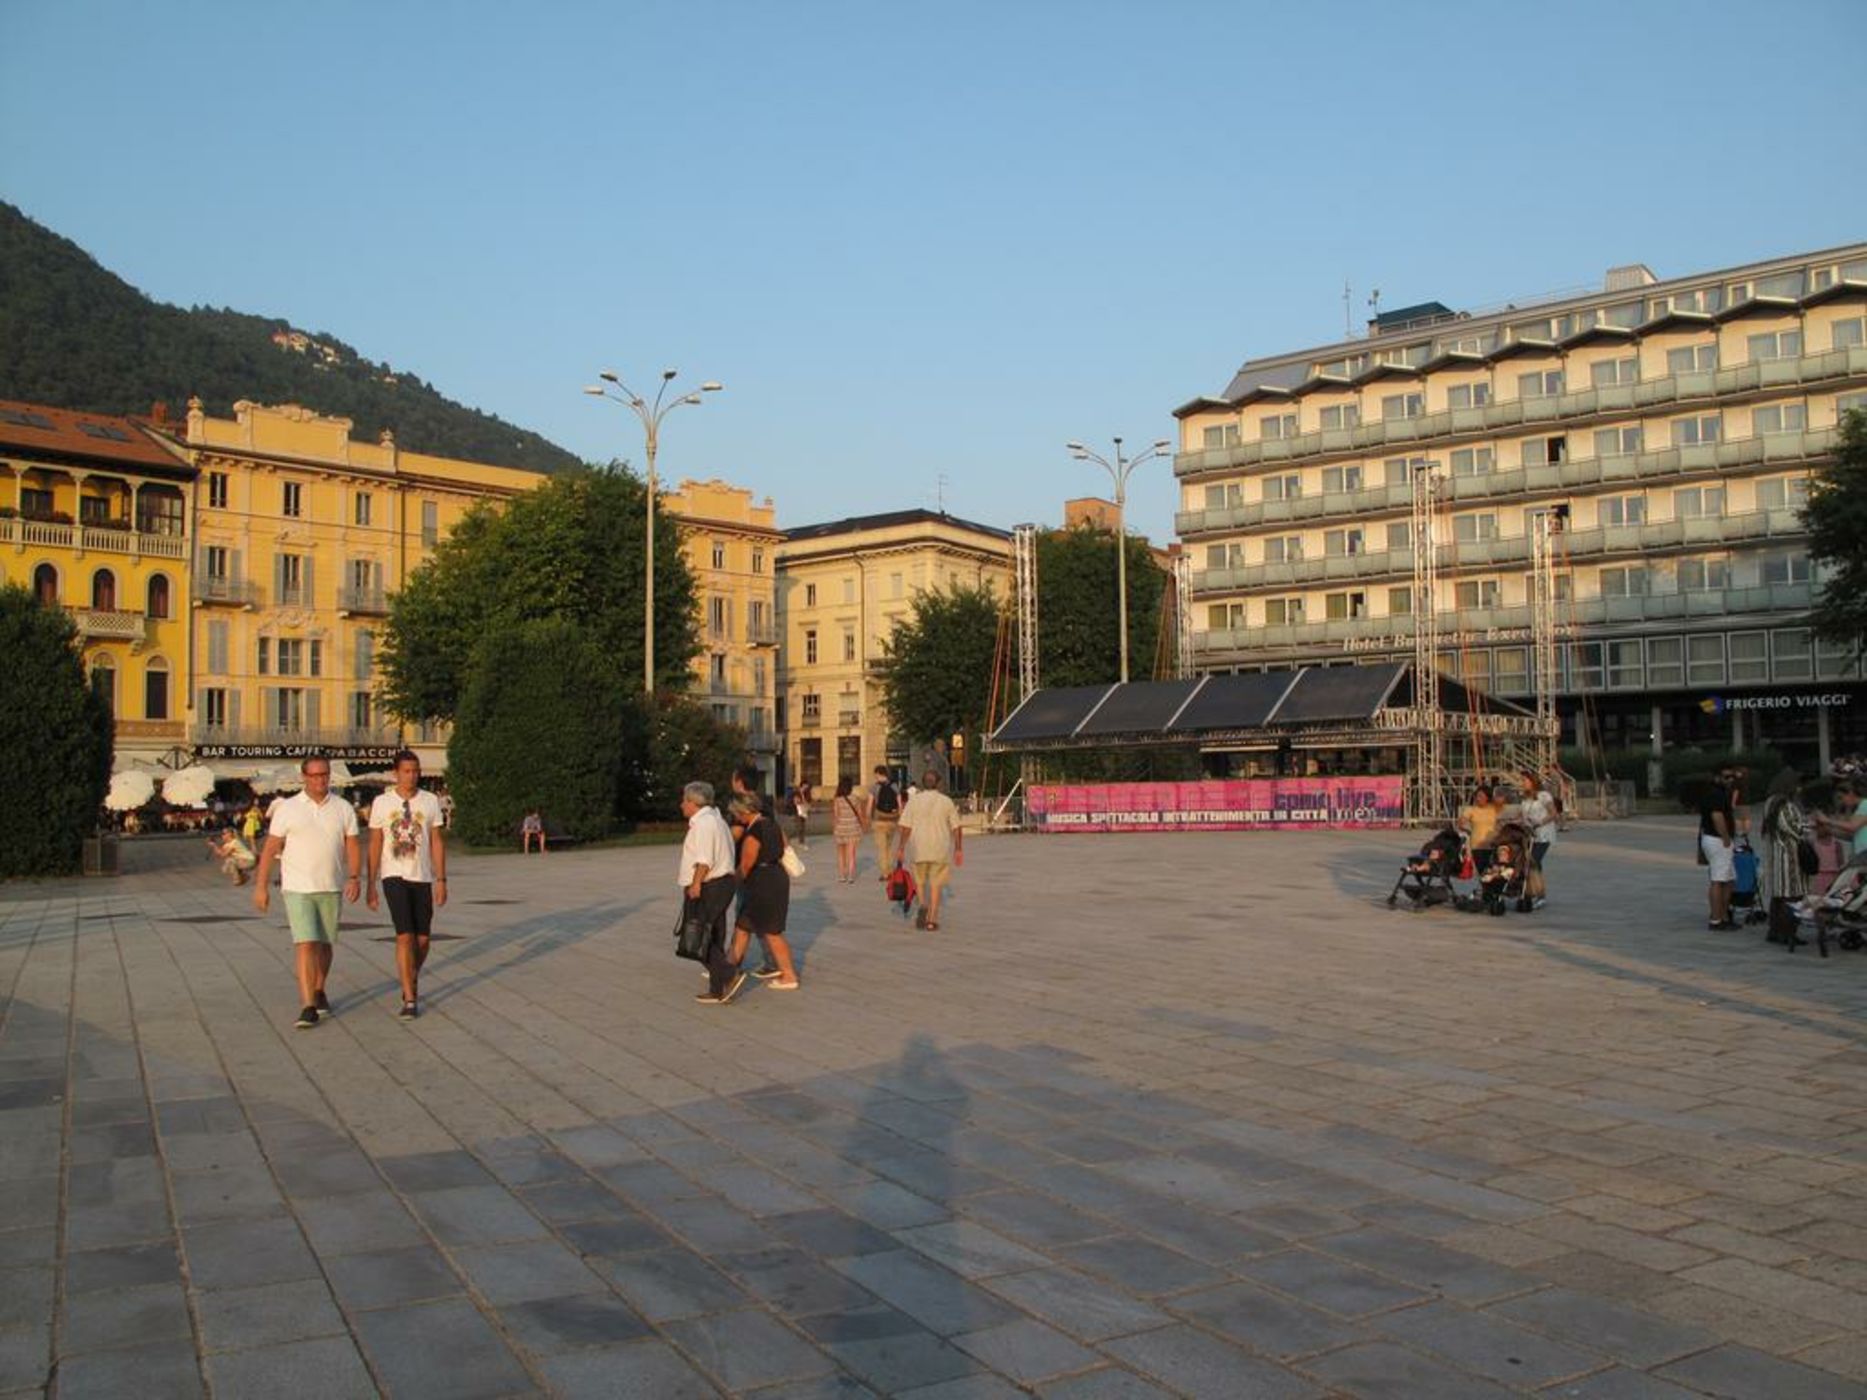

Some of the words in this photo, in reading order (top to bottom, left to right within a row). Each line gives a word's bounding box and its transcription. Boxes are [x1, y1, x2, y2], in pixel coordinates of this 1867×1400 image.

[1342, 636, 1386, 652] Hotel
[1725, 696, 1792, 709] FRIGERIO
[1796, 693, 1848, 707] VIAGGI
[202, 747, 226, 756] BAR
[230, 747, 282, 756] TOURING
[1273, 809, 1288, 821] IN
